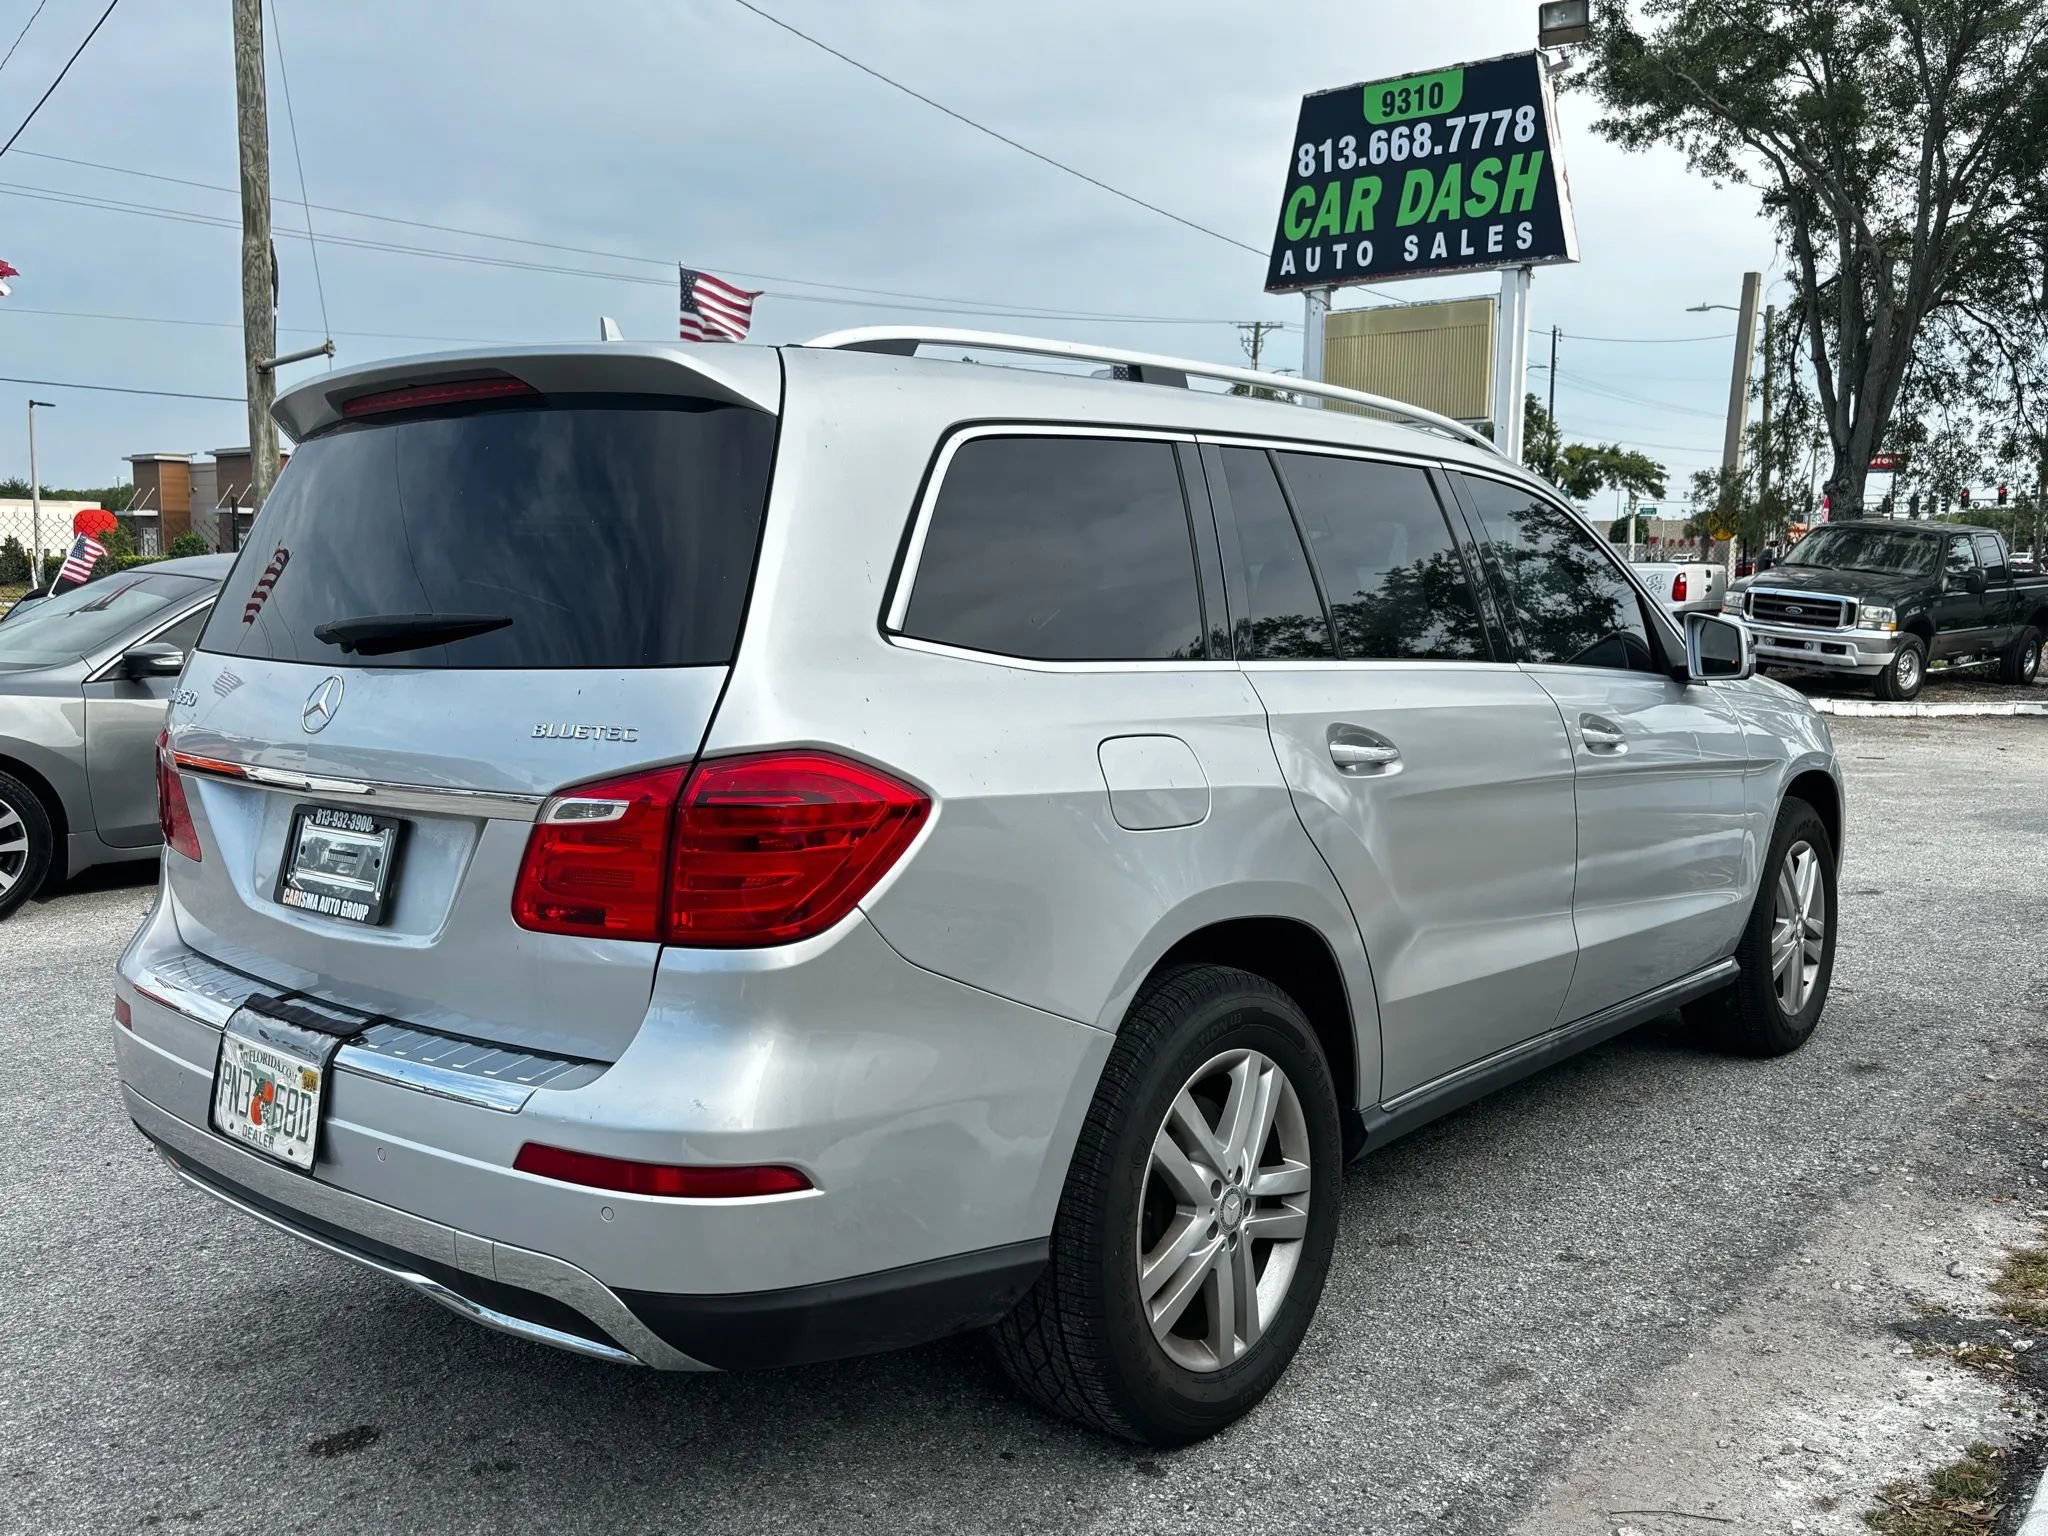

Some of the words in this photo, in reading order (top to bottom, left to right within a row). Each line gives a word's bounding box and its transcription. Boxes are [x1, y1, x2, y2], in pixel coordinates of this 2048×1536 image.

[1381, 81, 1444, 118] 9310
[1297, 105, 1536, 178] 813.668.7778
[1283, 175, 1383, 242] CAR
[1395, 150, 1545, 228] DASH
[1280, 241, 1374, 275] AUTO
[1403, 221, 1533, 262] SALES
[530, 722, 639, 743] BLUETEC
[315, 808, 374, 833] 813-932-3900
[282, 888, 319, 910] CARISMA
[318, 895, 341, 916] AUTO
[340, 900, 370, 922] GROUP
[242, 1124, 275, 1149] DEALER
